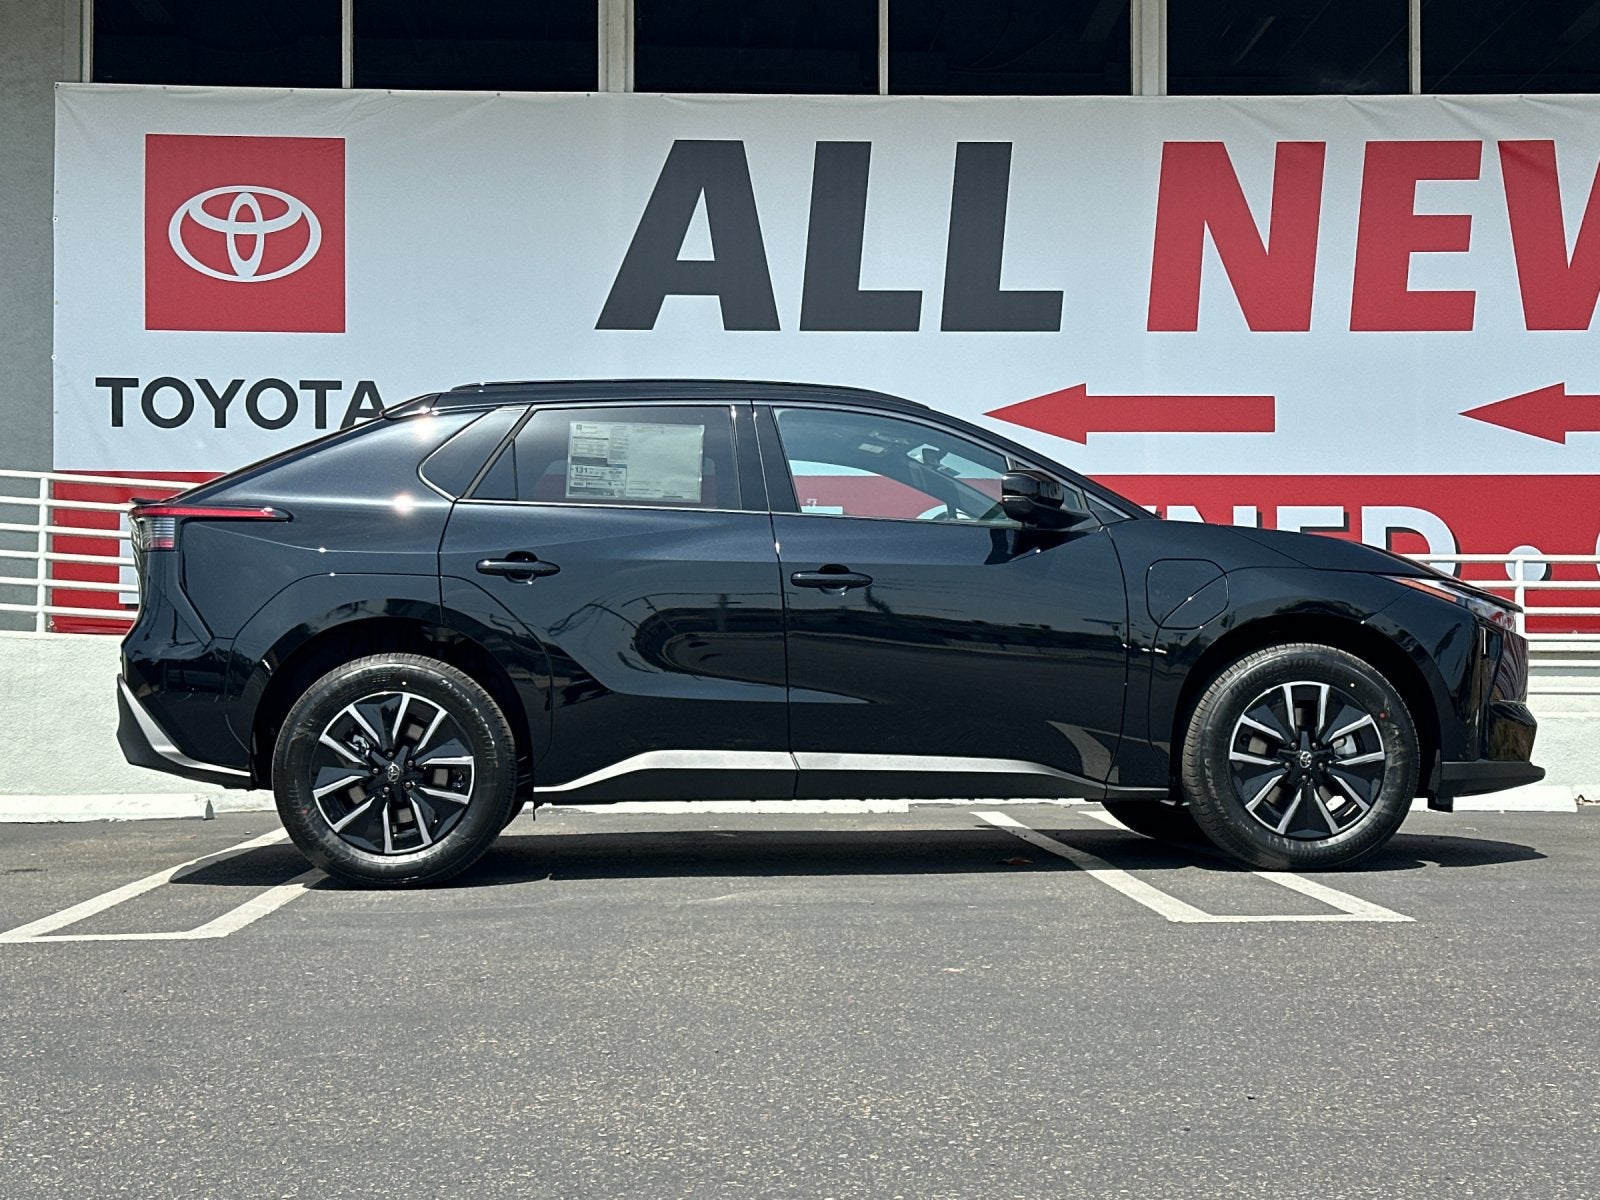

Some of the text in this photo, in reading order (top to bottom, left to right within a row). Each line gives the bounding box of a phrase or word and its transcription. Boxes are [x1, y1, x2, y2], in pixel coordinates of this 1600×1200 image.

[594, 140, 1064, 332] ALL
[95, 376, 386, 430] TOYOTA
[575, 466, 588, 474] 131
